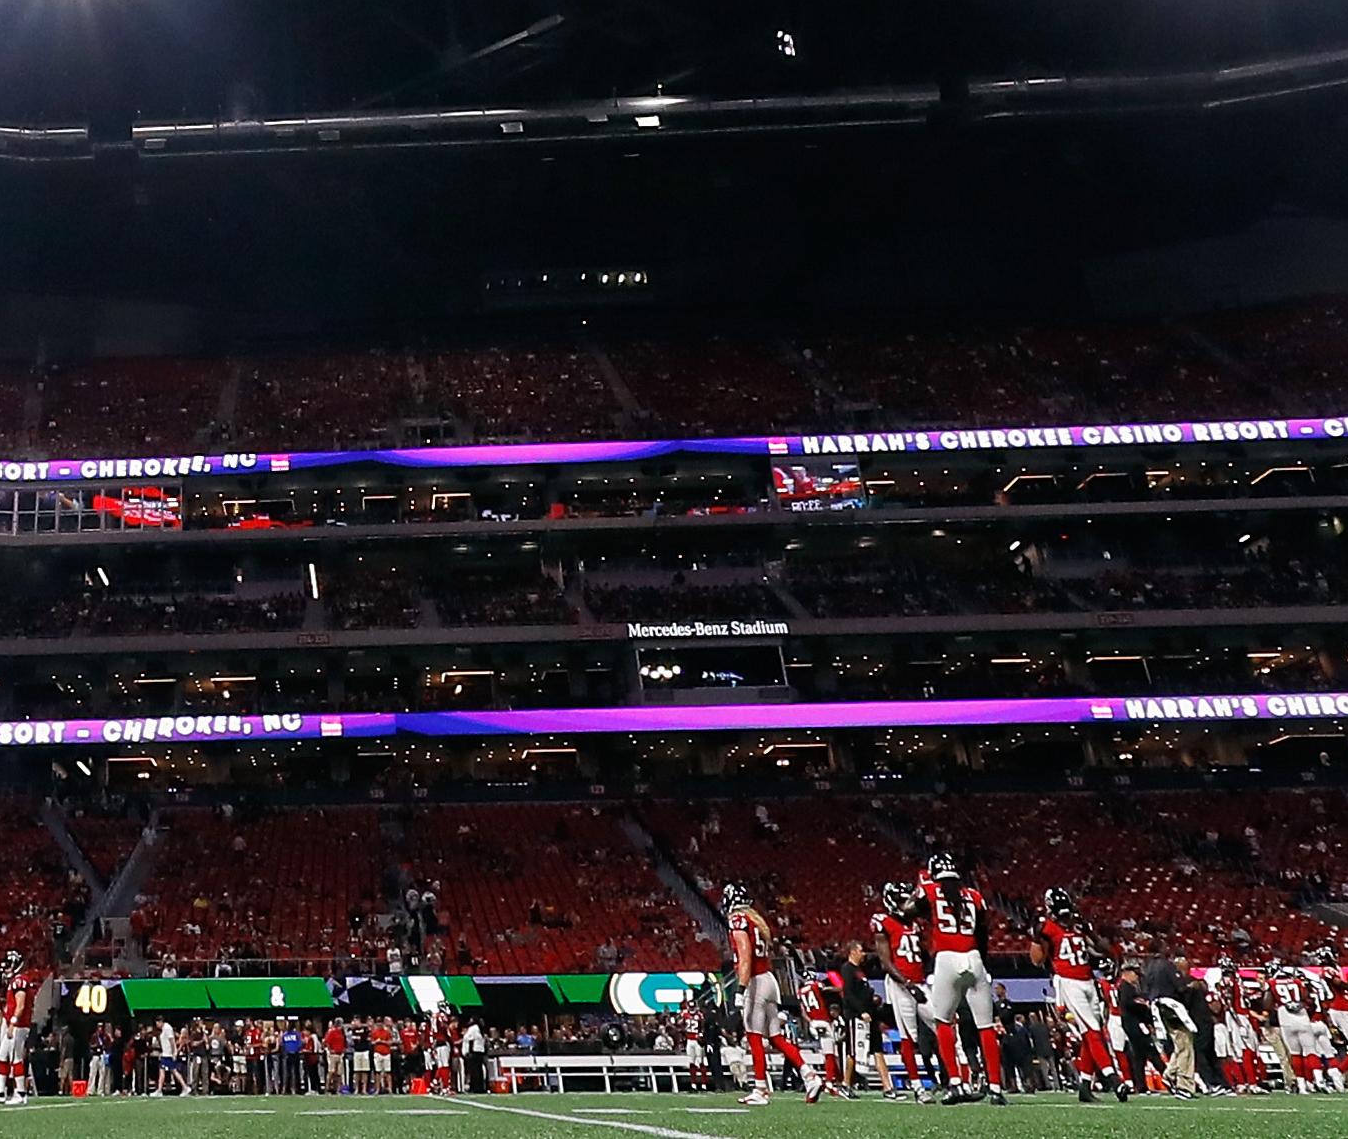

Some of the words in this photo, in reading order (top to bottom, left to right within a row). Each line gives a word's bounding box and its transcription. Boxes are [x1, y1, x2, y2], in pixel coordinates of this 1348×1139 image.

[802, 432, 930, 454] HARRAH'S
[940, 427, 1073, 450] CHEROKEE
[1082, 424, 1182, 445] CASINO
[1191, 420, 1288, 441] RESORT
[80, 455, 211, 478] CHEROKEE,
[222, 453, 256, 469] NC
[627, 622, 728, 639] Mercedes-Benz
[730, 619, 789, 636] Stadium
[1125, 696, 1258, 719] HARRAH'S
[102, 715, 251, 742] CHEROKEE,
[262, 713, 302, 732] NC
[896, 934, 920, 963] 45
[75, 984, 108, 1014] 40
[803, 994, 819, 1013] 14
[1276, 984, 1300, 1004] 97
[685, 1019, 699, 1033] 22
